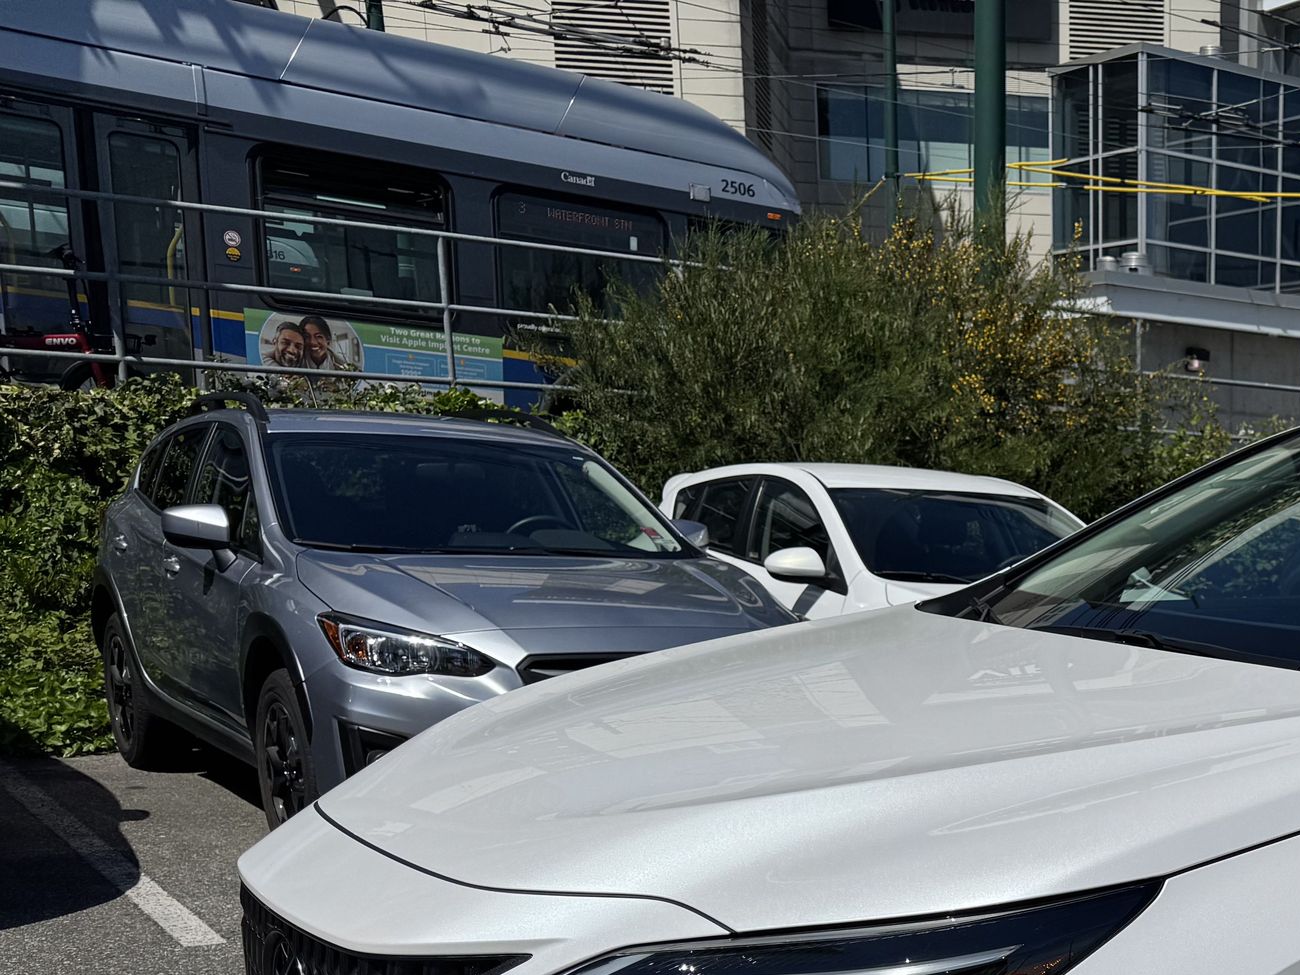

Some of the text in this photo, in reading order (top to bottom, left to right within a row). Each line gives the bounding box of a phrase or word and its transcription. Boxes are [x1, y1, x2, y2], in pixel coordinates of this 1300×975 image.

[721, 179, 756, 198] 2506
[547, 207, 609, 228] WATERFRONT
[45, 337, 77, 346] ENVO
[380, 334, 401, 344] Visit
[402, 337, 427, 348] Apple
[462, 344, 490, 355] Centre
[390, 327, 408, 336] Two
[410, 329, 434, 339] Great
[471, 337, 481, 345] to
